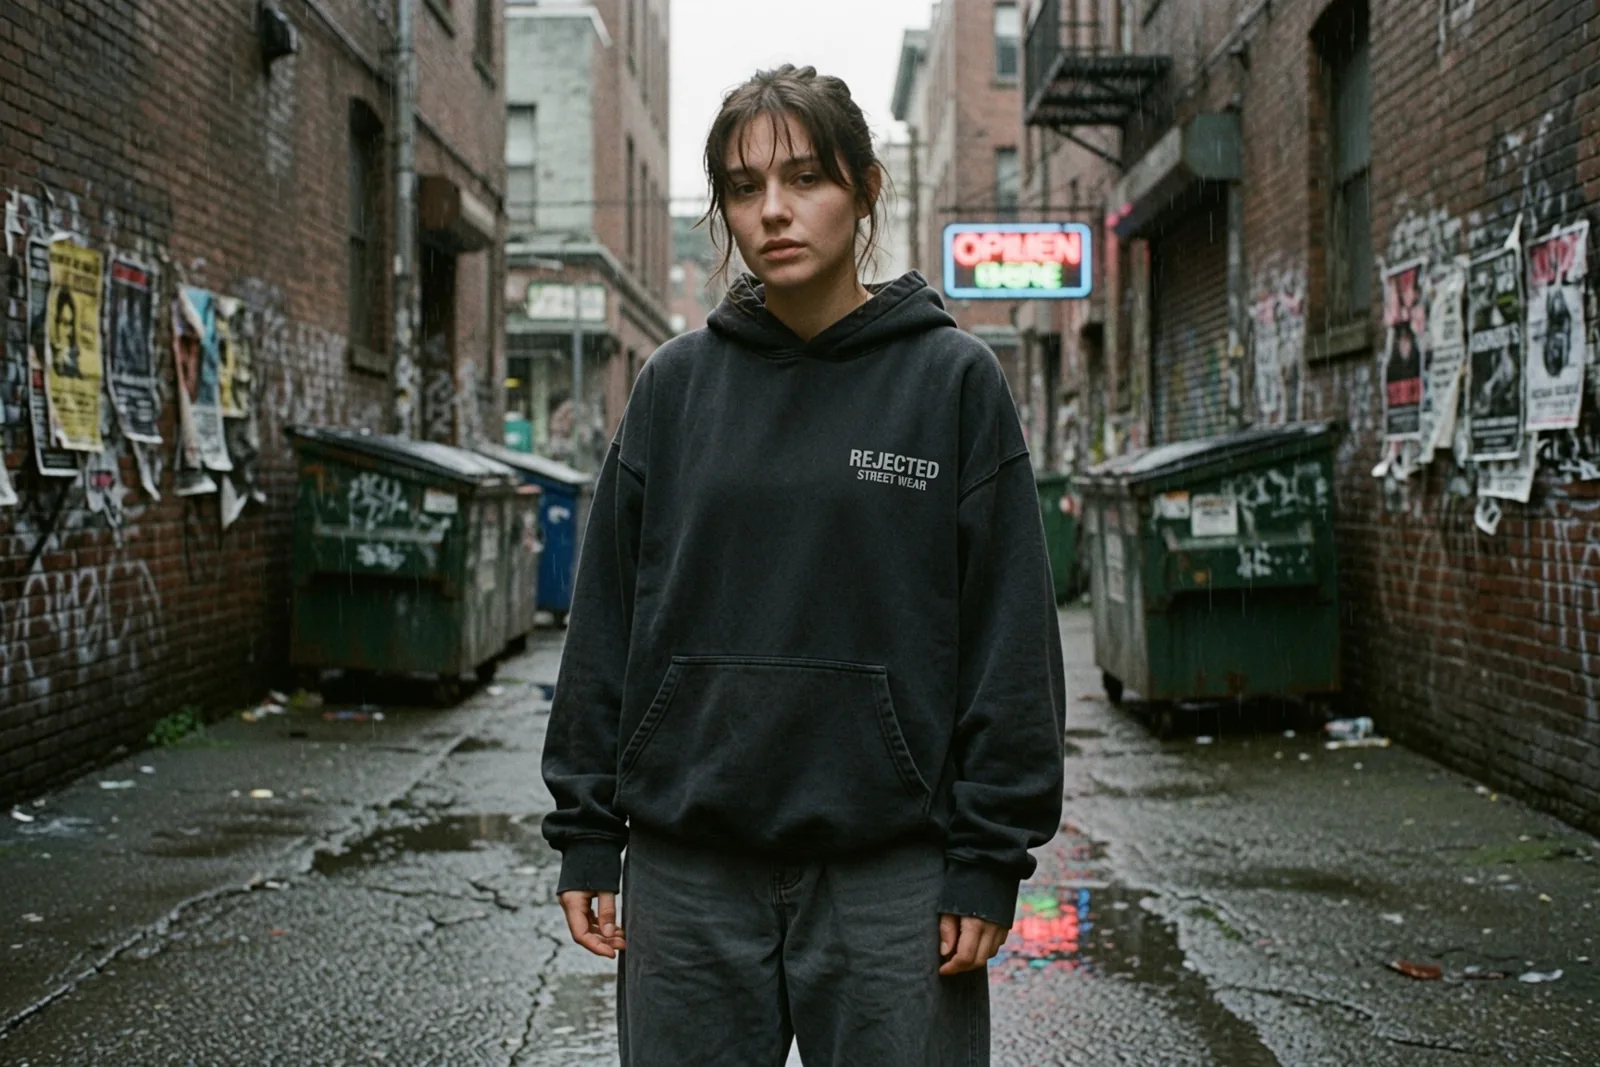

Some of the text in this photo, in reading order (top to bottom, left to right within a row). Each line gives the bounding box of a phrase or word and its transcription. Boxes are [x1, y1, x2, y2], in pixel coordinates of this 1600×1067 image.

[849, 448, 940, 479] REJECTED
[857, 469, 927, 491] STREET WEAR
